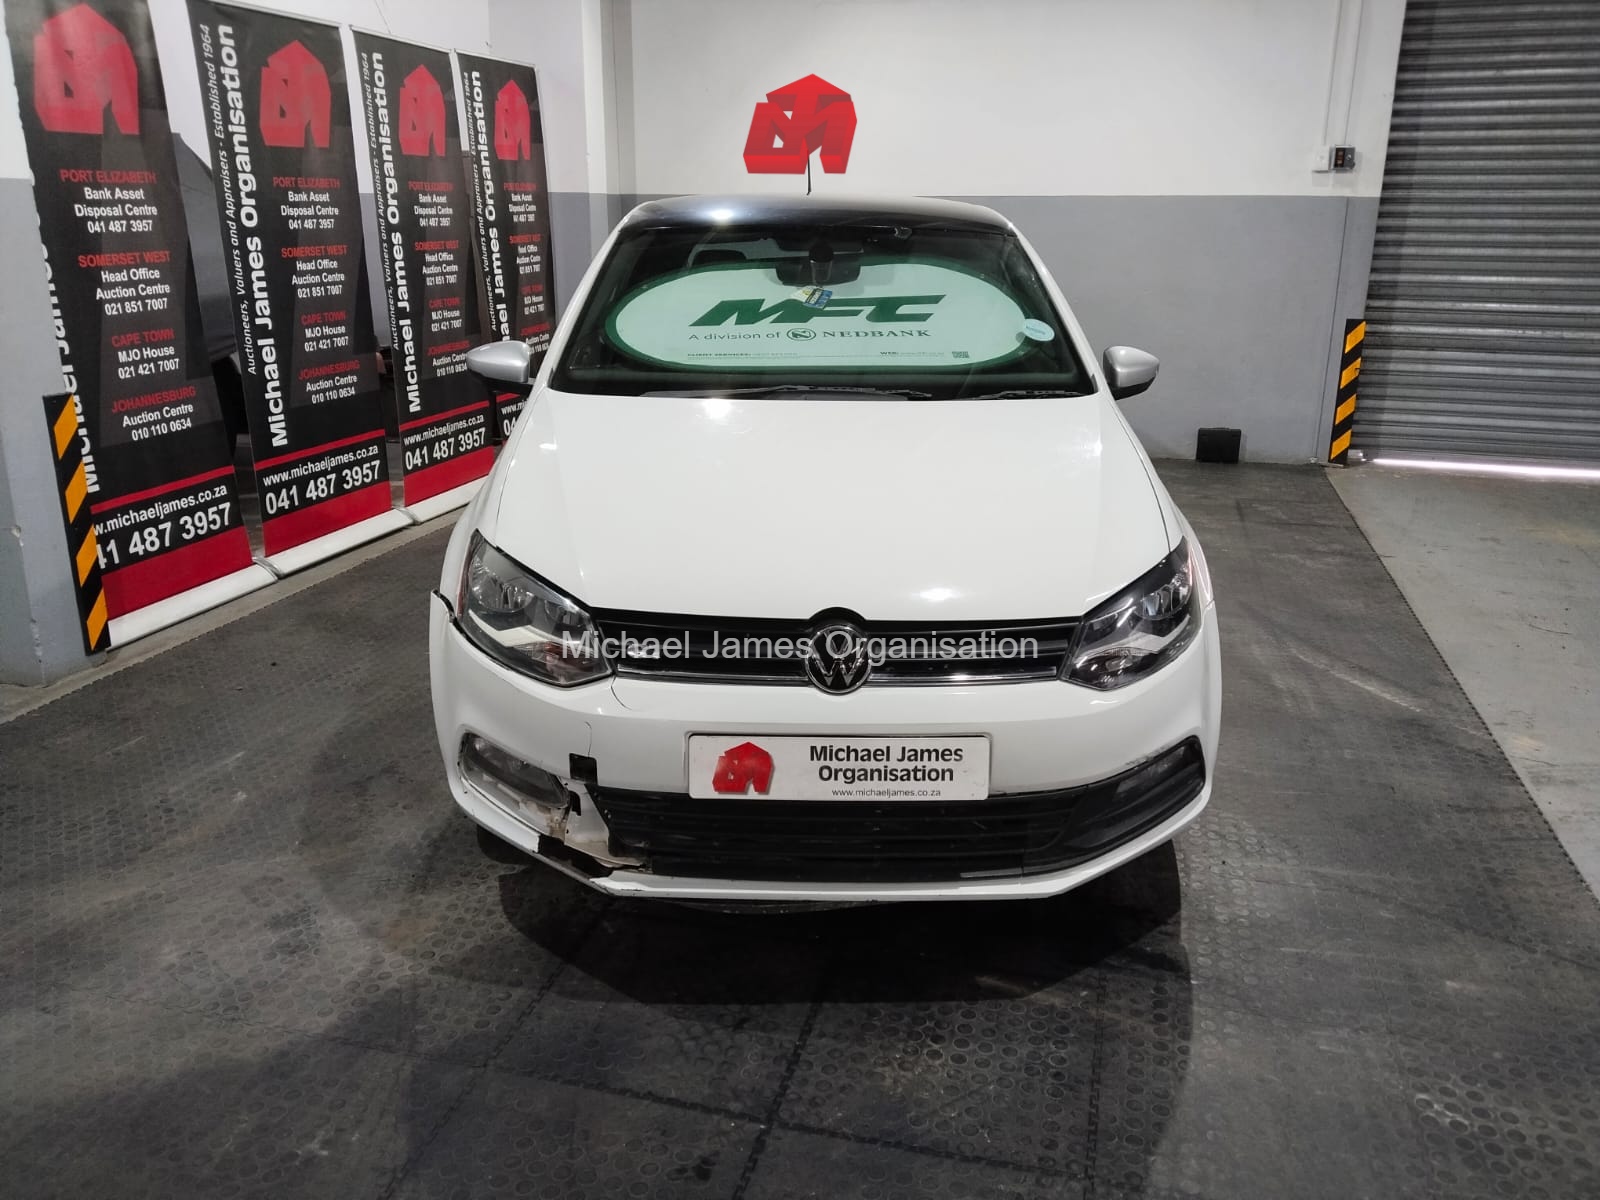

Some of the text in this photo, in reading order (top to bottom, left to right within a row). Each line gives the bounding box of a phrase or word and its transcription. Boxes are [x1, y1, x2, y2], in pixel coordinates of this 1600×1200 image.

[59, 169, 156, 184] PORT ELIZABETH
[84, 187, 145, 200] Bank Asset
[200, 23, 257, 375] Auctioneers, Valuers and Appraisers Established 1964
[288, 191, 330, 202] Bank Asset
[74, 204, 158, 219] Disposal Centre
[280, 205, 339, 217] Disposal Centre
[87, 220, 153, 233] 041 487 3957
[288, 219, 335, 229] 041 487 3957
[78, 251, 171, 268] SOMERSET WEST
[281, 246, 325, 258] SOMERSET
[296, 259, 338, 271] Head Office
[489, 227, 505, 298] James
[101, 268, 160, 283] Head Office
[292, 273, 345, 285] Auction Centre
[391, 231, 410, 312] James
[96, 283, 170, 300] Auction Centre
[246, 236, 272, 330] James
[297, 285, 342, 298] 021 851 7007
[105, 298, 168, 316] 021 851 7007
[687, 294, 947, 327] MFC
[111, 328, 175, 347] CAPE TOWN
[305, 325, 346, 338] MJO House
[823, 329, 932, 338] NEDBANK
[304, 336, 349, 352] 021 421 7007
[118, 346, 175, 363] MJO House
[118, 358, 179, 379] 021 421 7007
[399, 318, 422, 413] Michael
[306, 375, 357, 392] Auction Centre
[112, 386, 196, 413] JOHANNESBURG
[257, 338, 288, 447] Michael
[312, 387, 355, 404] 010 110 0634
[122, 404, 193, 428] Auction Centre
[132, 417, 192, 441] 010 110 0634
[403, 414, 485, 446] www.michaeljames.co.za
[405, 427, 486, 470] 041 487 3957
[263, 444, 379, 487] www.michaeljames.co.za
[266, 460, 381, 515] 041 487 3957
[128, 522, 172, 556] 487
[179, 502, 231, 540] 3957
[810, 745, 964, 762] Michael James
[818, 765, 954, 785] Organisation
[832, 788, 941, 799] www.michaeljames.co.za
